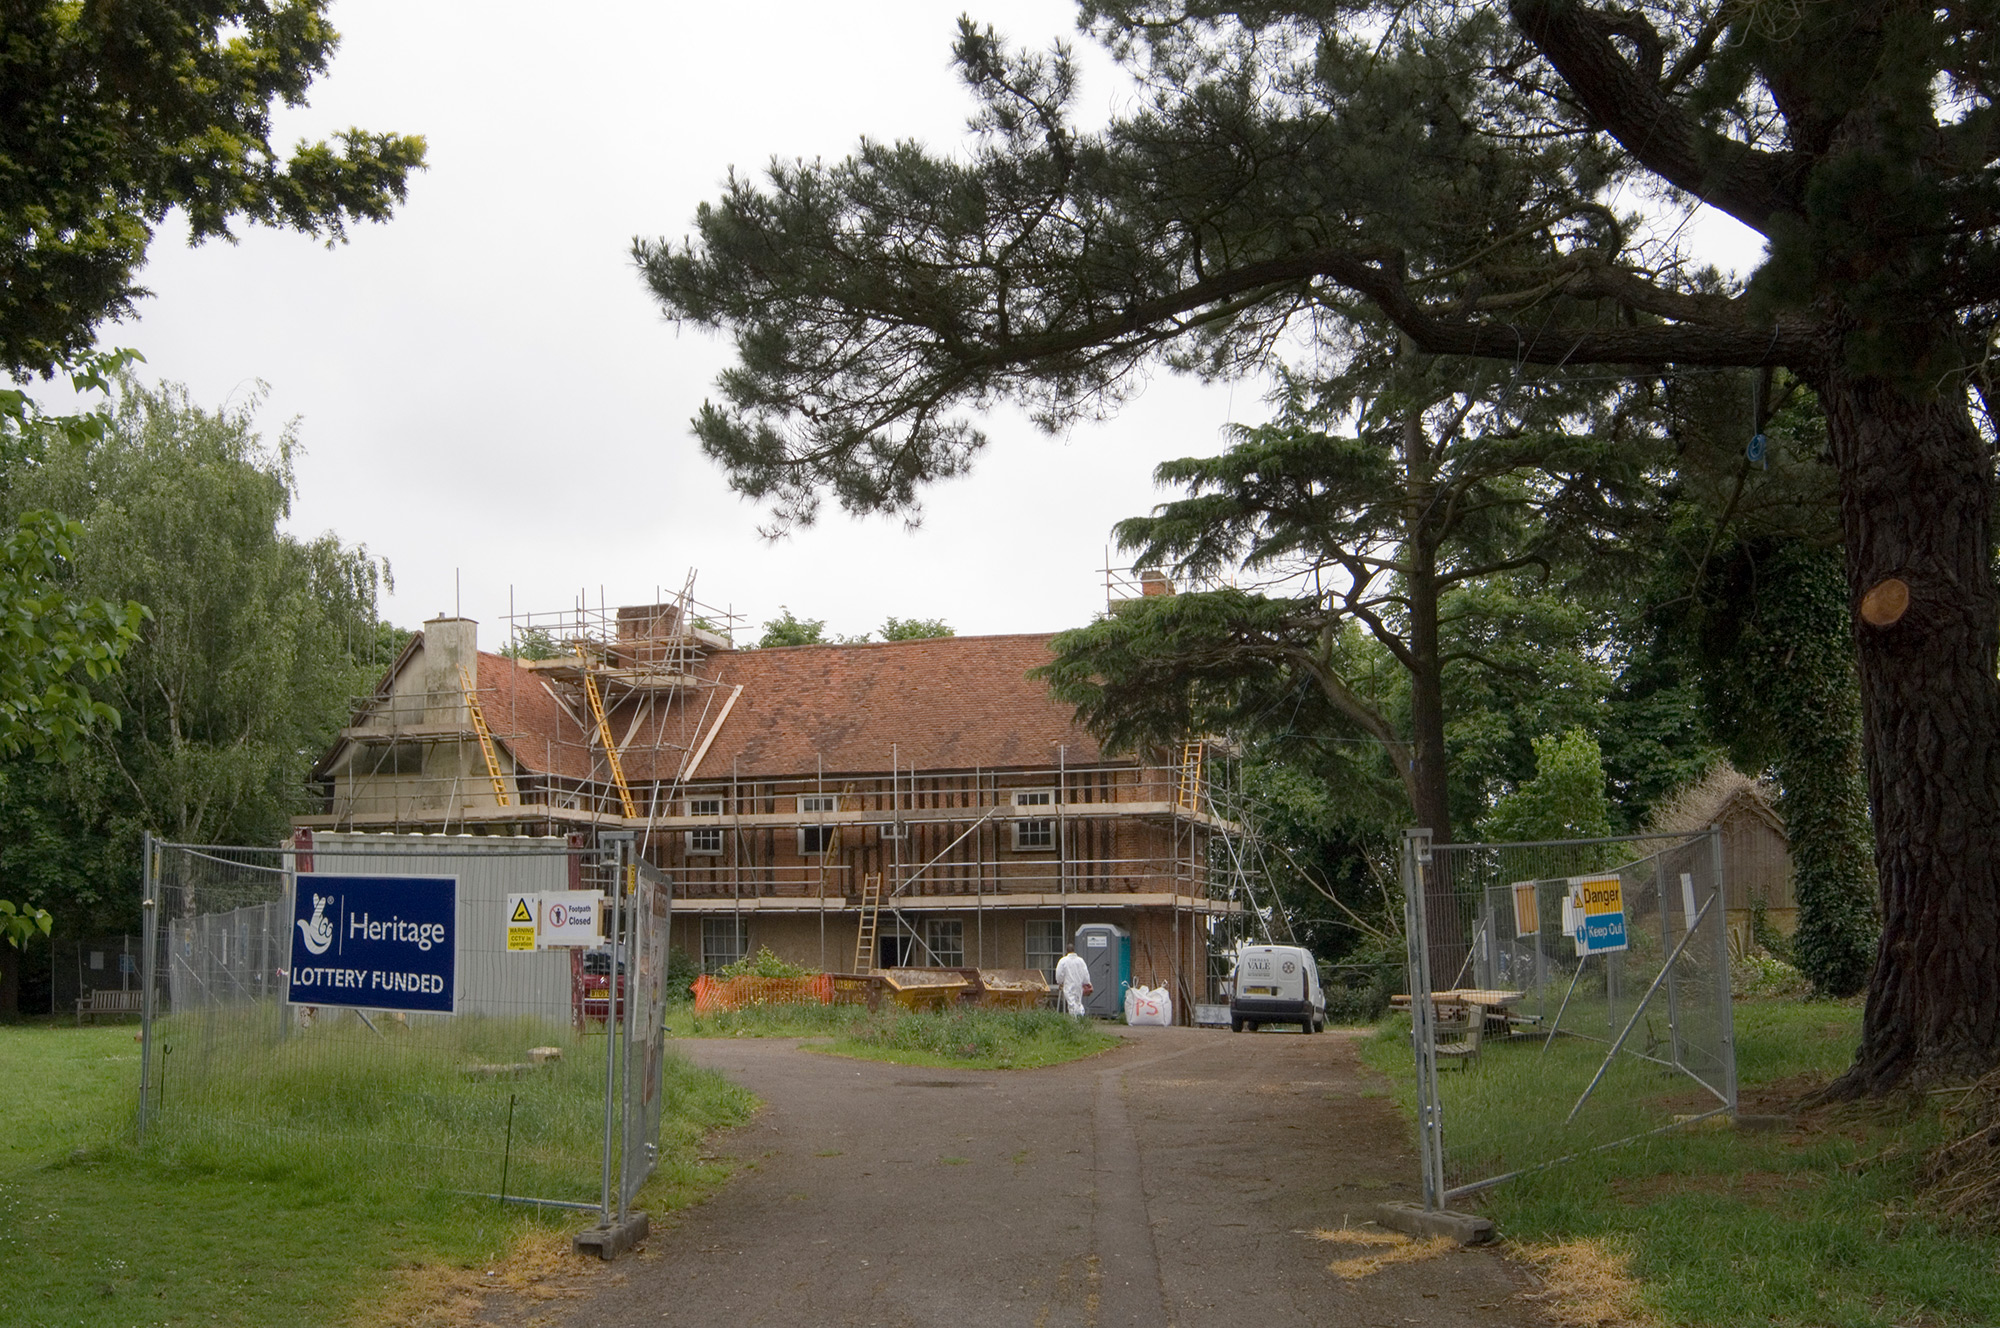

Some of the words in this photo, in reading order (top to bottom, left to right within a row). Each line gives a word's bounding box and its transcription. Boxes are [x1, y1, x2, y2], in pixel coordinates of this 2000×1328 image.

[1584, 888, 1619, 906] Danger
[568, 905, 591, 913] Footpath
[569, 916, 591, 925] Closed
[350, 912, 445, 951] Heritage
[1588, 925, 1608, 939] Keep
[1609, 922, 1623, 935] Out
[1247, 962, 1271, 970] VALE
[292, 967, 368, 988] LOTTERY
[371, 971, 444, 994] FUNDED
[1136, 998, 1158, 1016] PS
